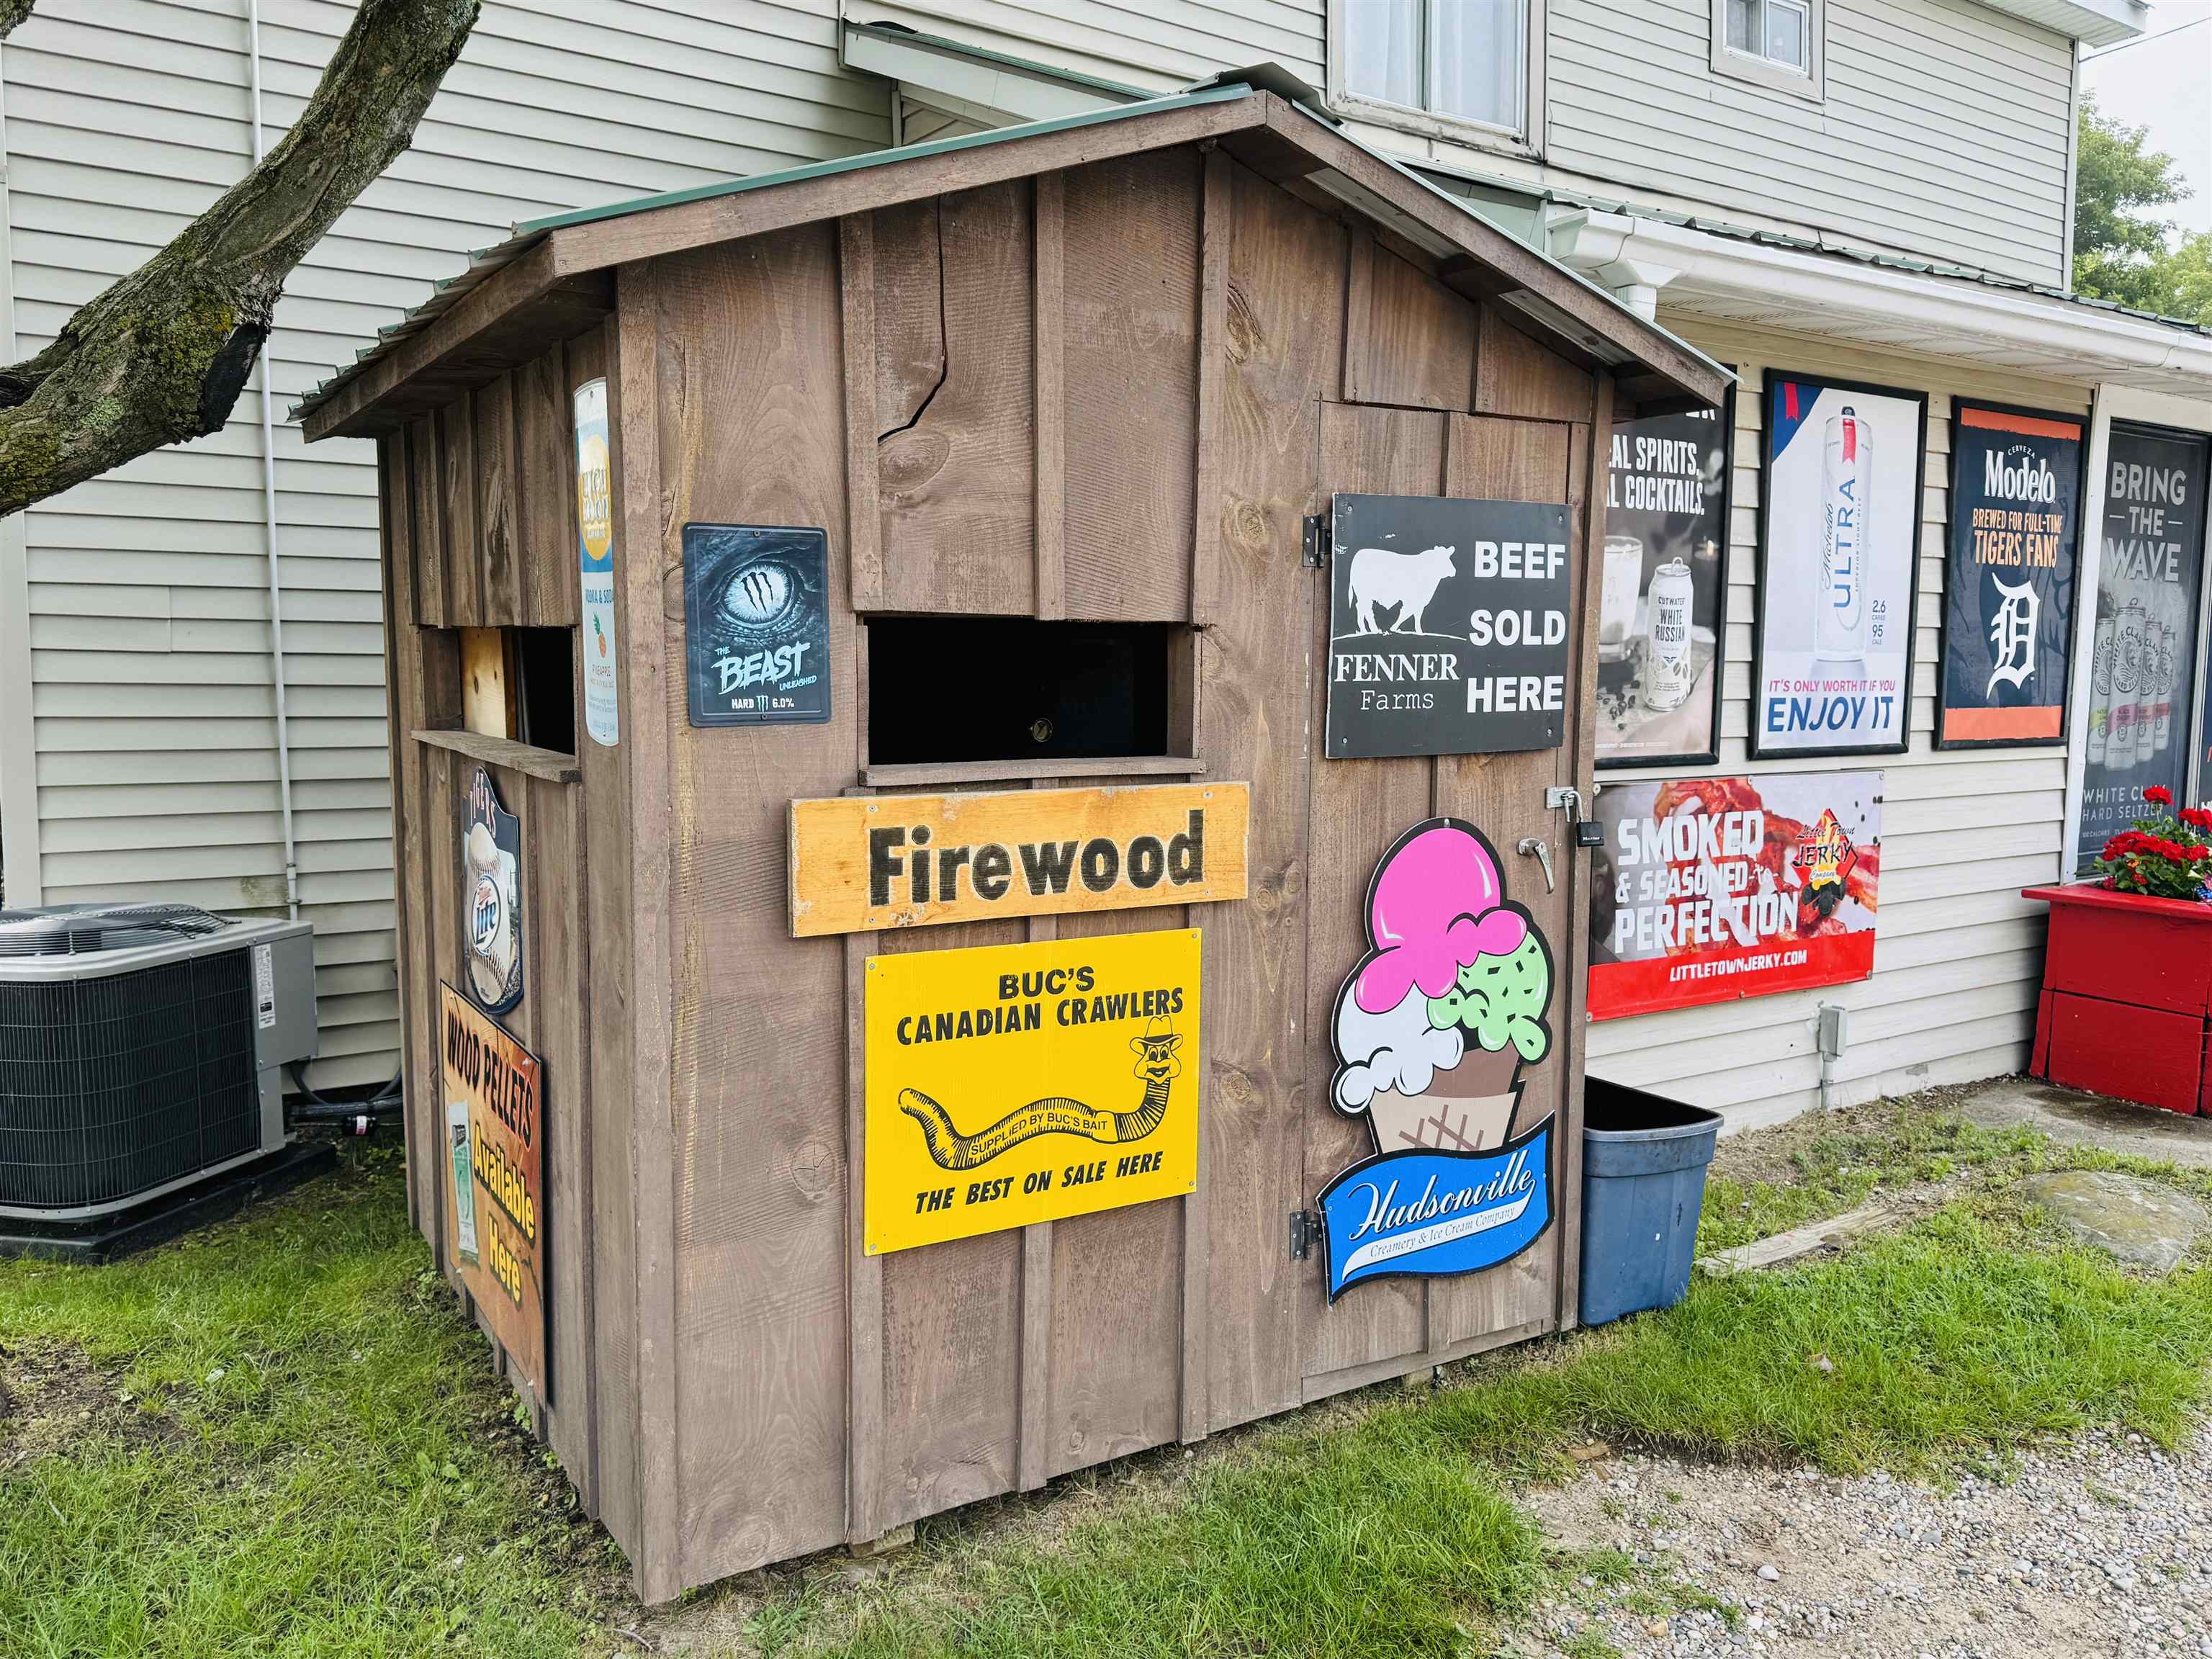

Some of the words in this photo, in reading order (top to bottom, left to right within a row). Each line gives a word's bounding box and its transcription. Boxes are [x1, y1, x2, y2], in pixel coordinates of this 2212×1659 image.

[1609, 434, 1632, 469] AL
[1635, 436, 1700, 476] SPIRITS.
[2008, 444, 2036, 459] CERVEZA
[1625, 475, 1705, 516] COCKTAILS.
[1984, 449, 2056, 504] Modelo
[2110, 461, 2187, 505] BRING
[1972, 508, 2006, 530] BREWED
[2008, 511, 2023, 531] FOR
[2024, 512, 2063, 534] FULL-TIME
[2128, 506, 2165, 536] THE
[1474, 541, 1566, 579] BEEF
[1820, 502, 1834, 590] Michelob
[1833, 475, 1856, 608] ULTRA
[1974, 530, 2022, 566] TIGERS
[2026, 534, 2059, 568] FANS
[2107, 537, 2182, 582] WAVE
[1660, 608, 1683, 626] WHITE
[1872, 599, 1887, 613] 2.6
[1469, 609, 1566, 646] SOLD
[1655, 625, 1686, 642] RUSSIAN
[1872, 624, 1884, 638] 95
[711, 641, 811, 696] BEAST
[714, 646, 731, 657] THE
[1334, 653, 1460, 683] FENNER
[778, 675, 817, 692] UNLEASHED
[1360, 689, 1434, 711] Farms
[1467, 675, 1564, 713] HERE
[1769, 678, 1790, 692] IT'S
[1794, 680, 1820, 692] ONLY
[1822, 679, 1858, 692] WORTH
[1859, 680, 1867, 691] IT
[1869, 680, 1877, 691] IF
[1879, 680, 1896, 691] YOU
[732, 698, 755, 709] HARD
[772, 698, 794, 709] 6.0%
[1767, 696, 1866, 732] ENJOY
[1871, 696, 1894, 729] IT
[469, 772, 497, 840] TIGERS
[2083, 786, 2126, 804] WHITE
[2081, 808, 2113, 822] HARD
[1617, 809, 1764, 866] SMOKED
[1792, 841, 1853, 866] JERKY
[869, 809, 1205, 907] Firewood
[1616, 872, 1630, 904] &
[1639, 861, 1749, 902] SEASONED
[475, 900, 497, 945] Lite
[1614, 891, 1799, 954] PERFECTION
[998, 966, 1095, 1000] BUC'S
[1670, 949, 1807, 982] LITTLETOWNJERKY.COM
[896, 1005, 1041, 1046] CANADIAN
[1057, 987, 1184, 1027] CRAWLERS
[446, 1008, 480, 1092] WOOD
[482, 1043, 533, 1150] PELLETS
[971, 1120, 1027, 1156] SUPPLIED
[1029, 1112, 1045, 1128] BY
[1047, 1112, 1081, 1128] BUC'S
[1082, 1119, 1107, 1132] BAIT
[475, 1122, 536, 1241] Available
[916, 1187, 955, 1215] THE
[966, 1177, 1014, 1205] BEST
[1023, 1170, 1053, 1195] ON
[1061, 1161, 1107, 1188] SALE
[1115, 1151, 1164, 1179] HERE
[1347, 1149, 1536, 1241] Hudsonville
[1370, 1234, 1416, 1258] Creamery
[1418, 1231, 1429, 1245] &
[1429, 1227, 1443, 1242] Ice
[1444, 1219, 1473, 1238] Cream
[1475, 1206, 1516, 1229] Company
[489, 1213, 521, 1303] Here
